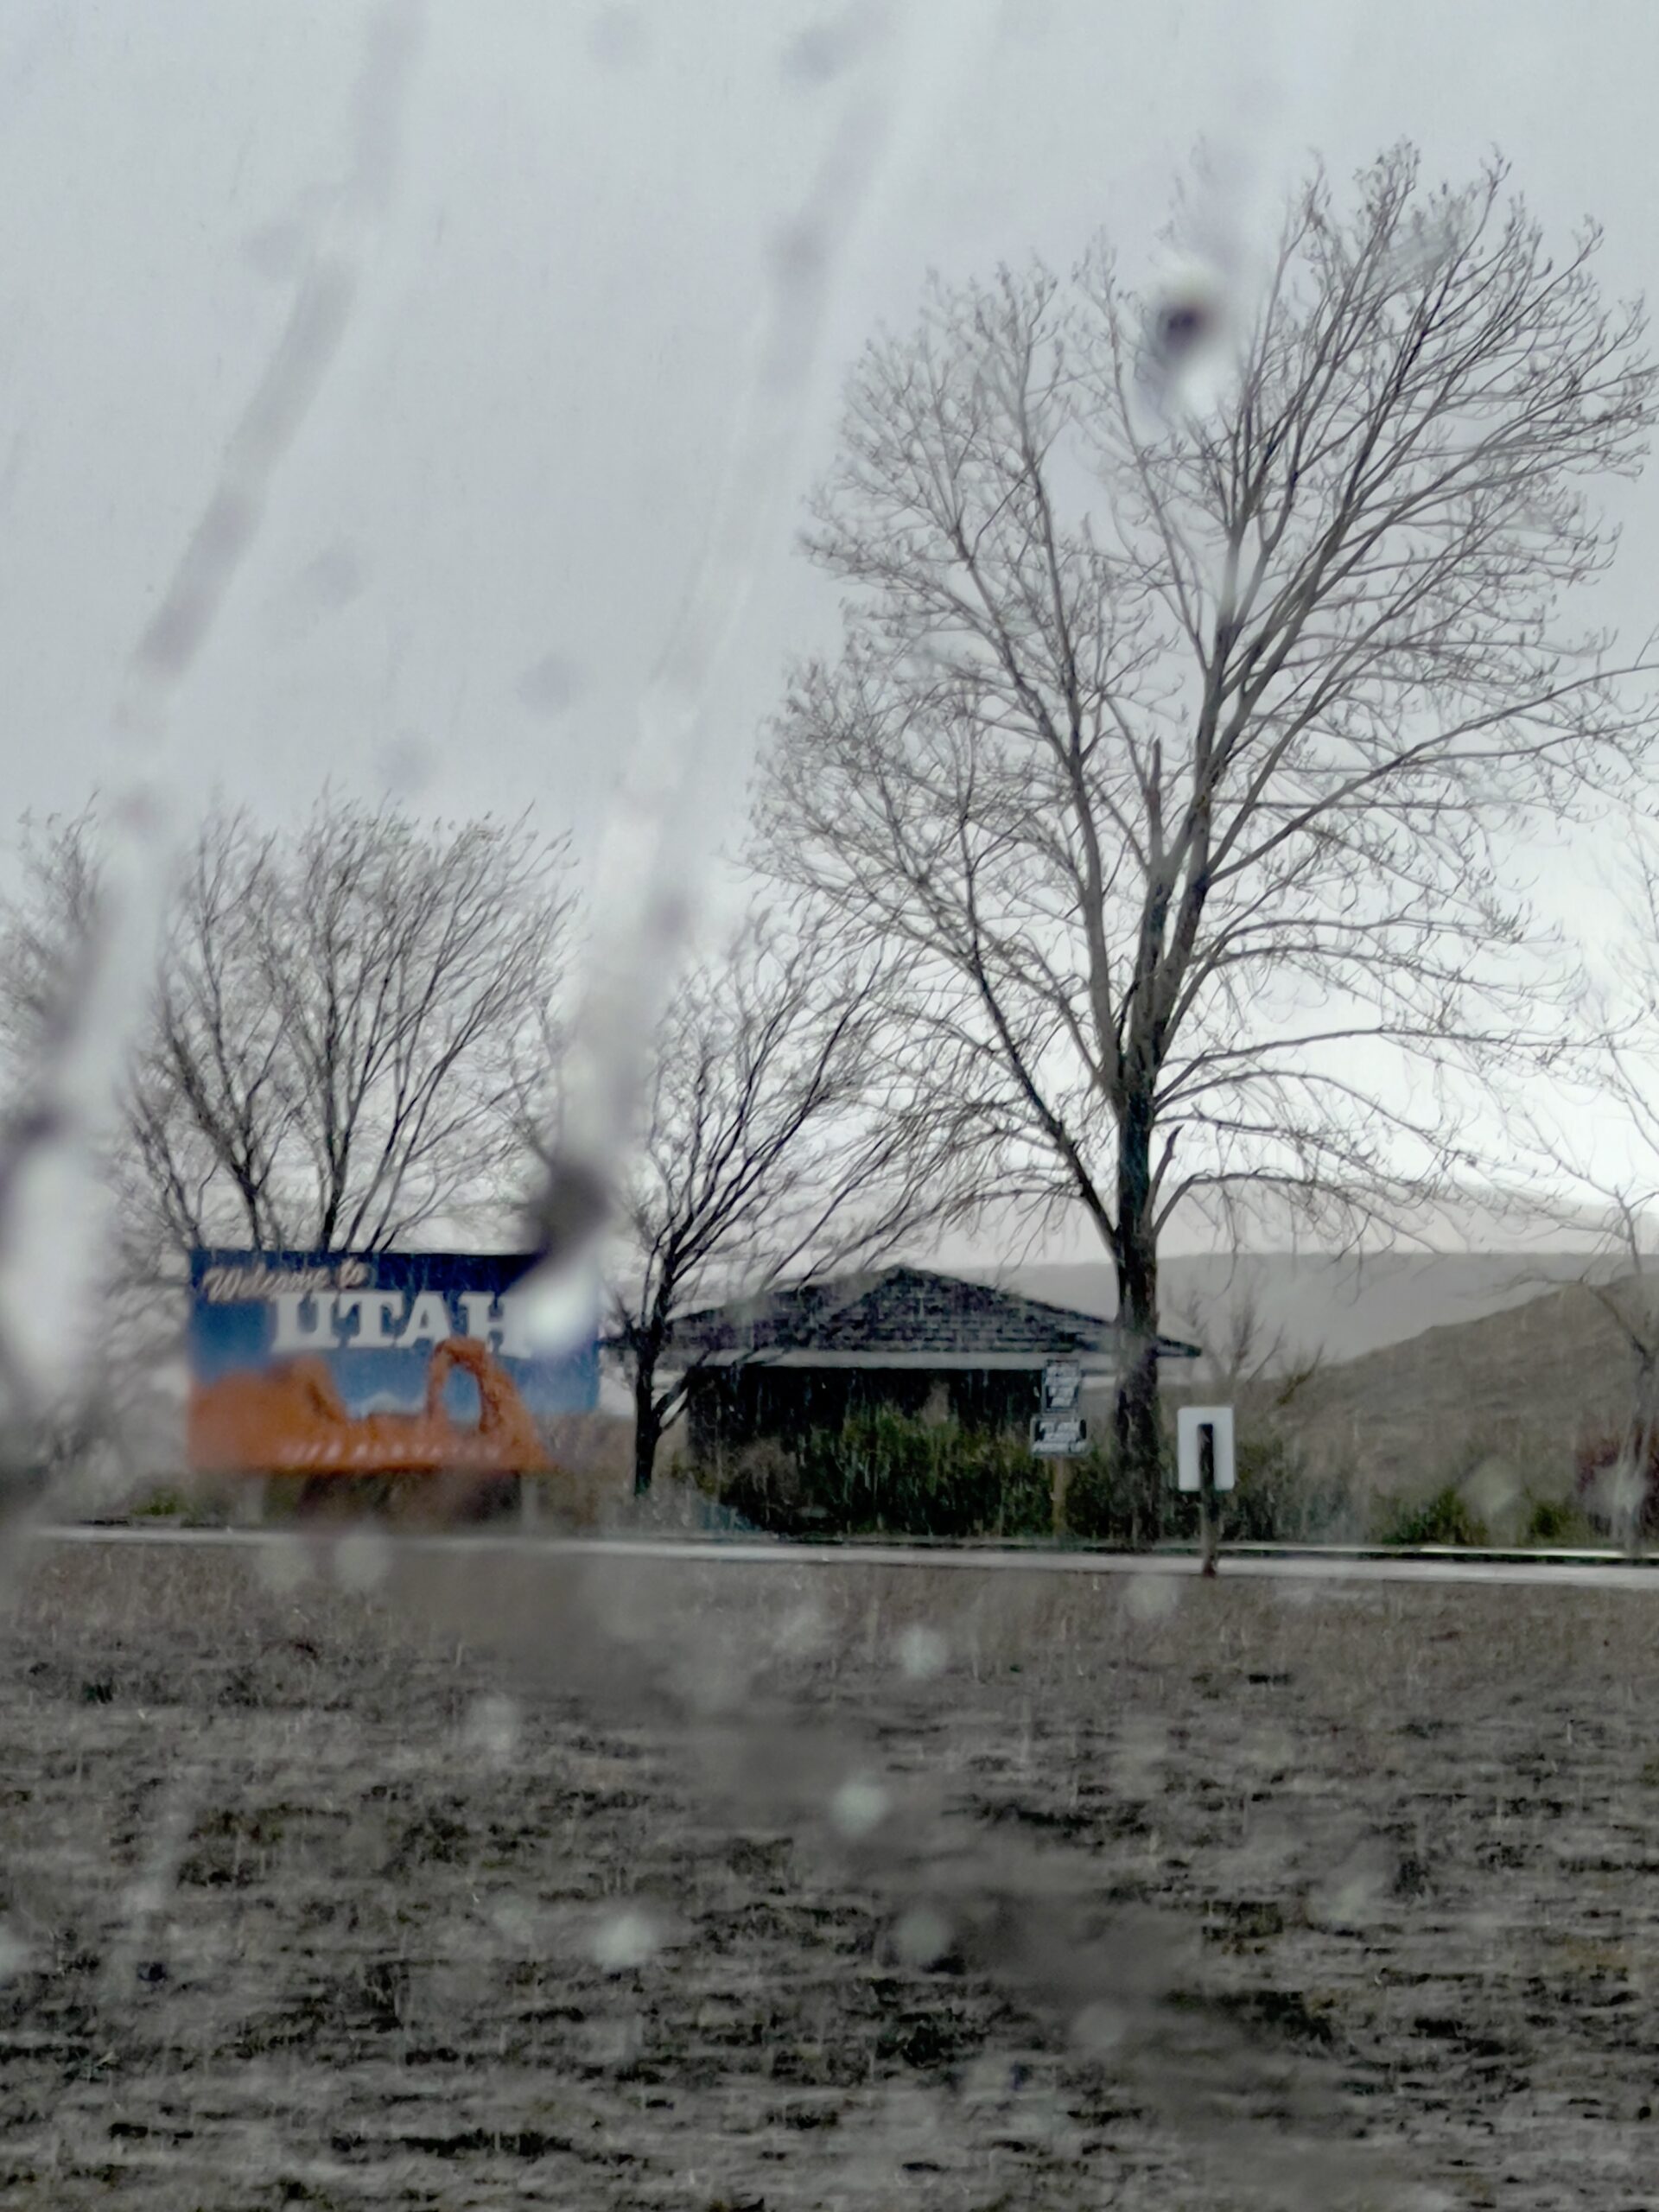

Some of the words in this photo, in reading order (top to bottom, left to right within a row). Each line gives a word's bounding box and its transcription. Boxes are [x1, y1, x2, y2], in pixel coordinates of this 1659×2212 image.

[202, 1263, 329, 1303] Welcome
[340, 1257, 367, 1288] to
[273, 1291, 536, 1357] UTAH
